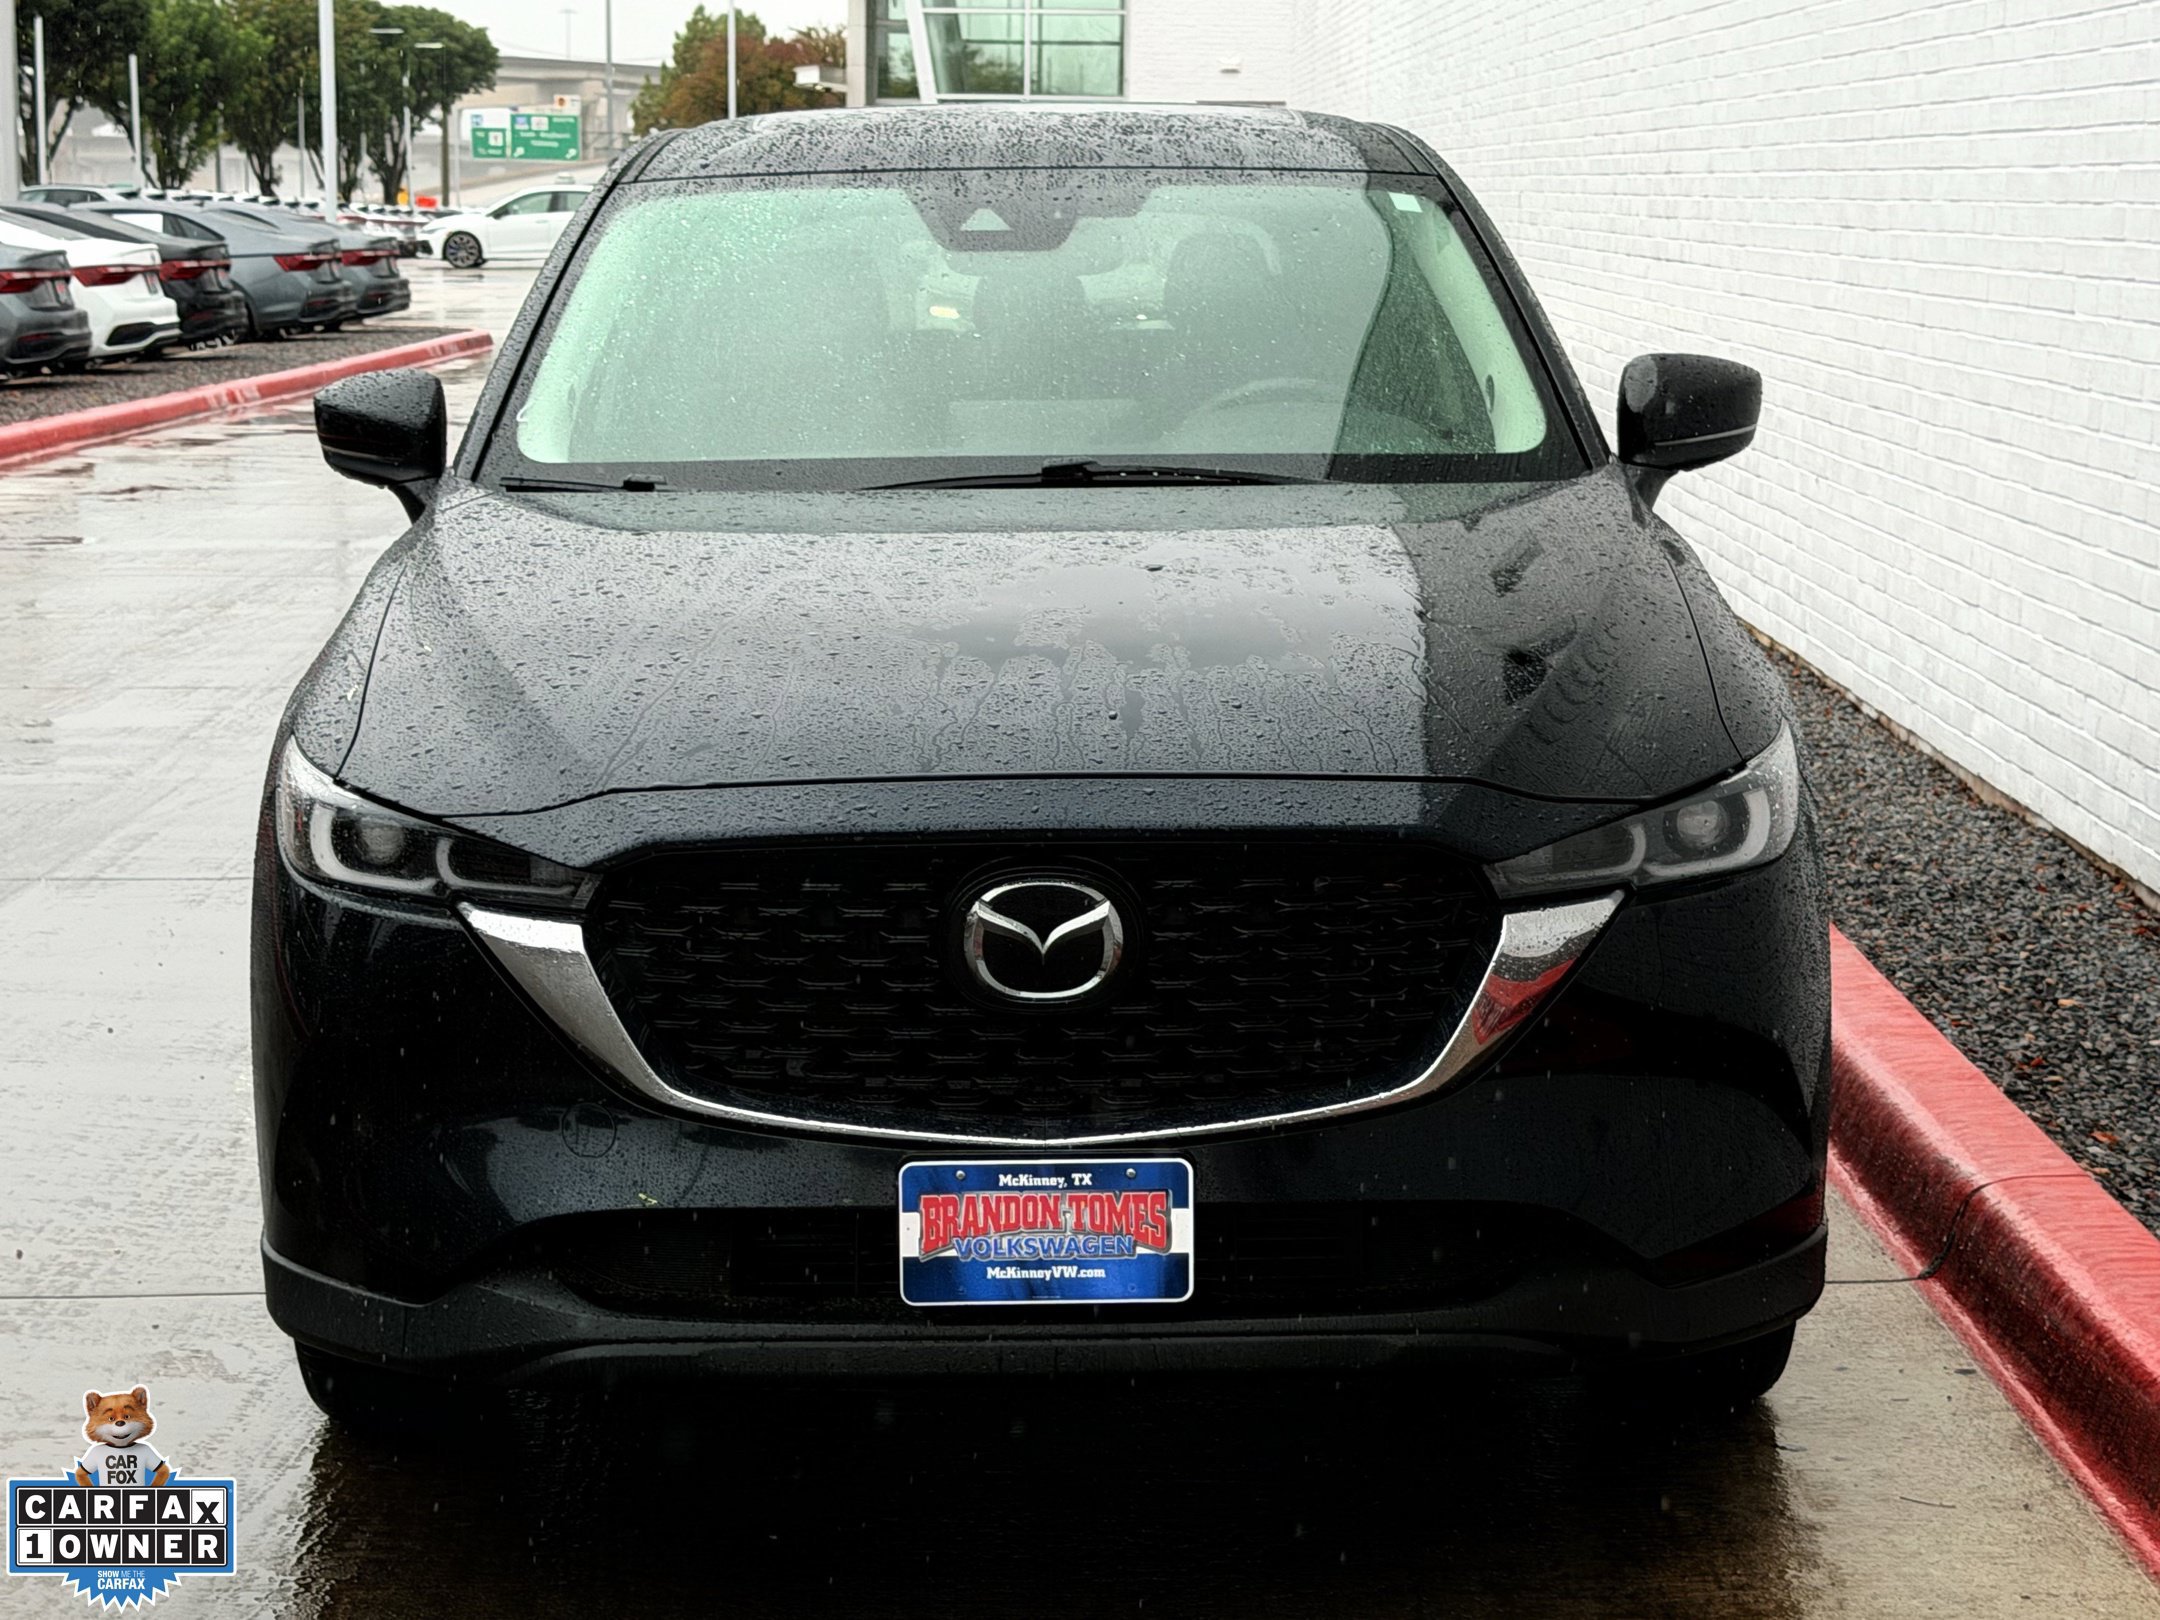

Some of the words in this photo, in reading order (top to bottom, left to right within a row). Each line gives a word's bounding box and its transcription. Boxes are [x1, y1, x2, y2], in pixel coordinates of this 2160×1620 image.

[998, 1174, 1068, 1188] McKinney,
[1071, 1172, 1092, 1186] TX
[920, 1193, 1062, 1255] BRANDON
[1065, 1191, 1168, 1249] TOMES
[952, 1234, 1134, 1259] VOLKSWAGEN
[986, 1265, 1106, 1281] McKinneyVW.com
